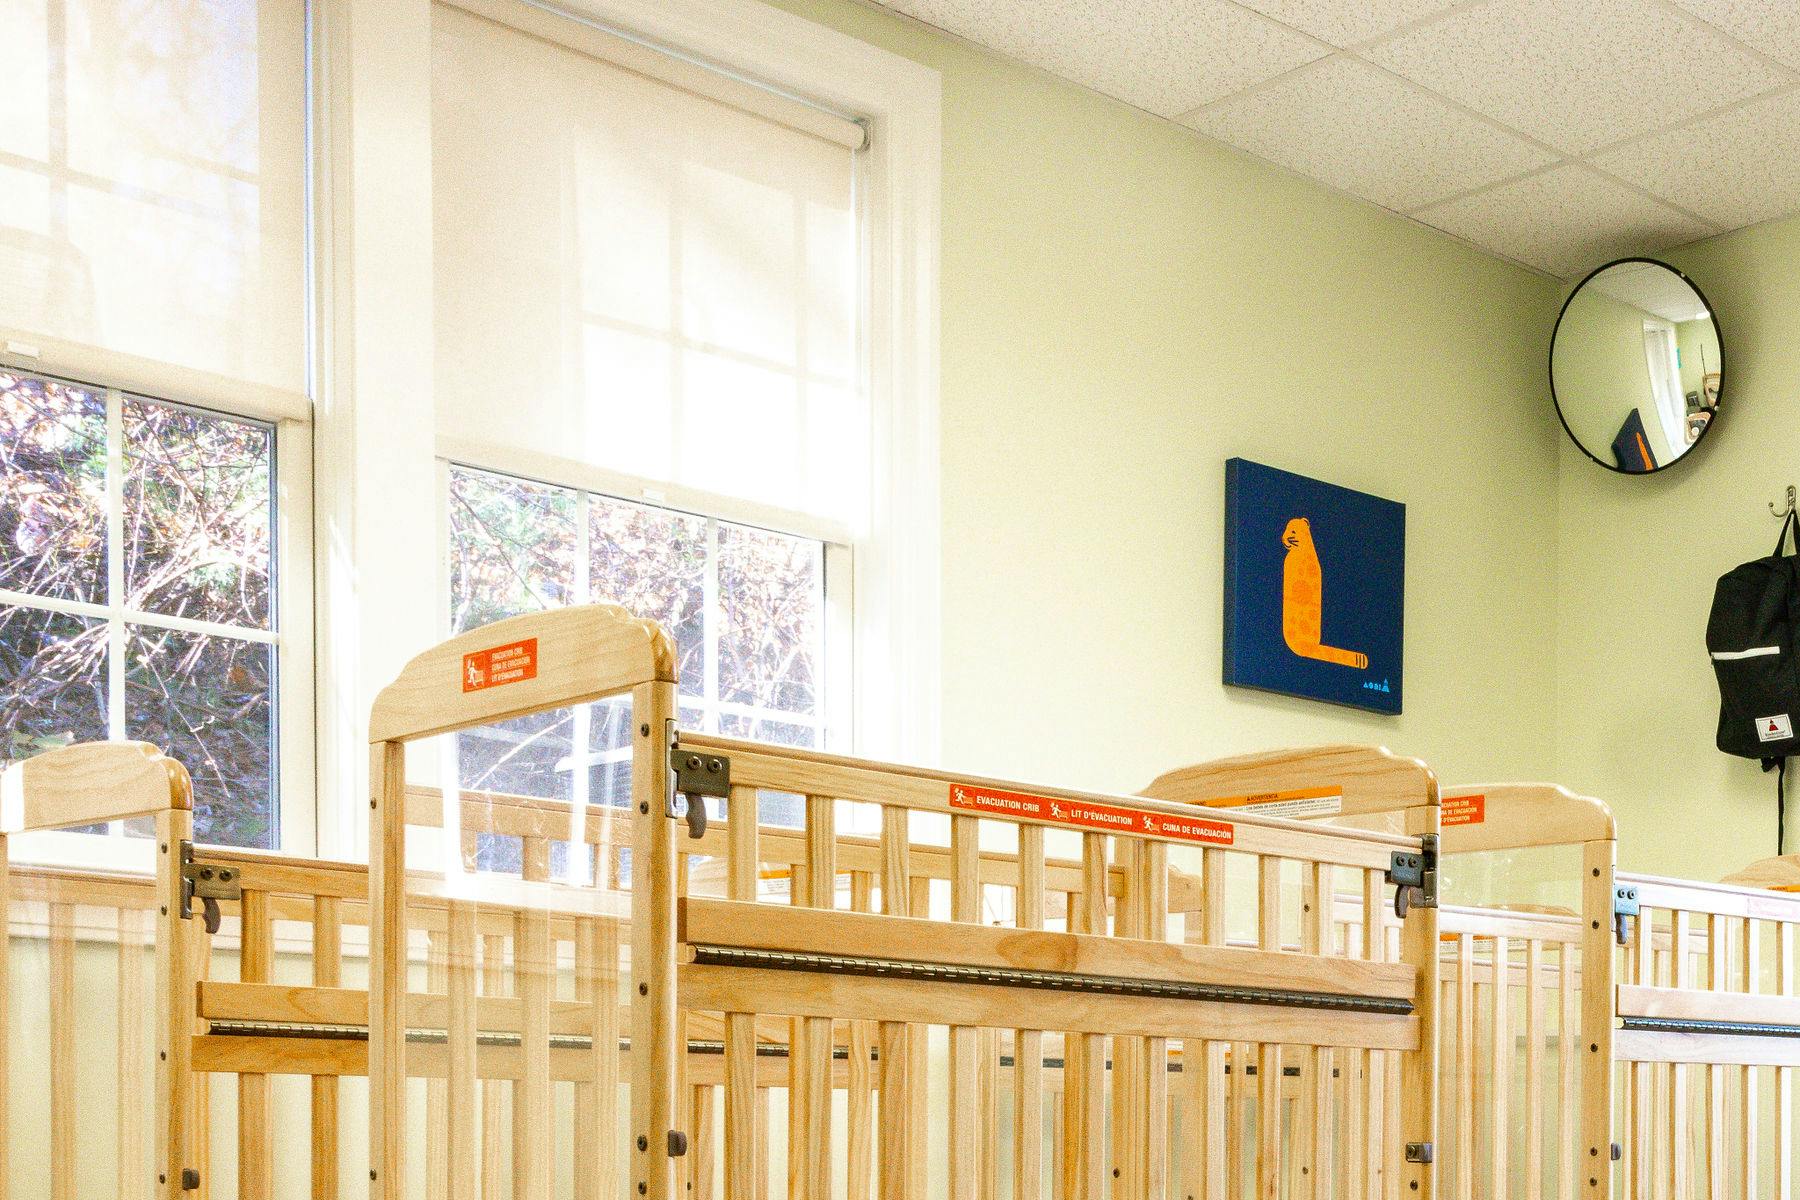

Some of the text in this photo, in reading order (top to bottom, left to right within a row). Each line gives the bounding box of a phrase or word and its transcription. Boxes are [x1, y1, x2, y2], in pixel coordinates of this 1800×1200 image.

[976, 795, 1040, 812] EVACUATION CRIB
[1071, 809, 1081, 818] LIT
[1162, 822, 1180, 833] CUNA
[1182, 825, 1191, 833] DE
